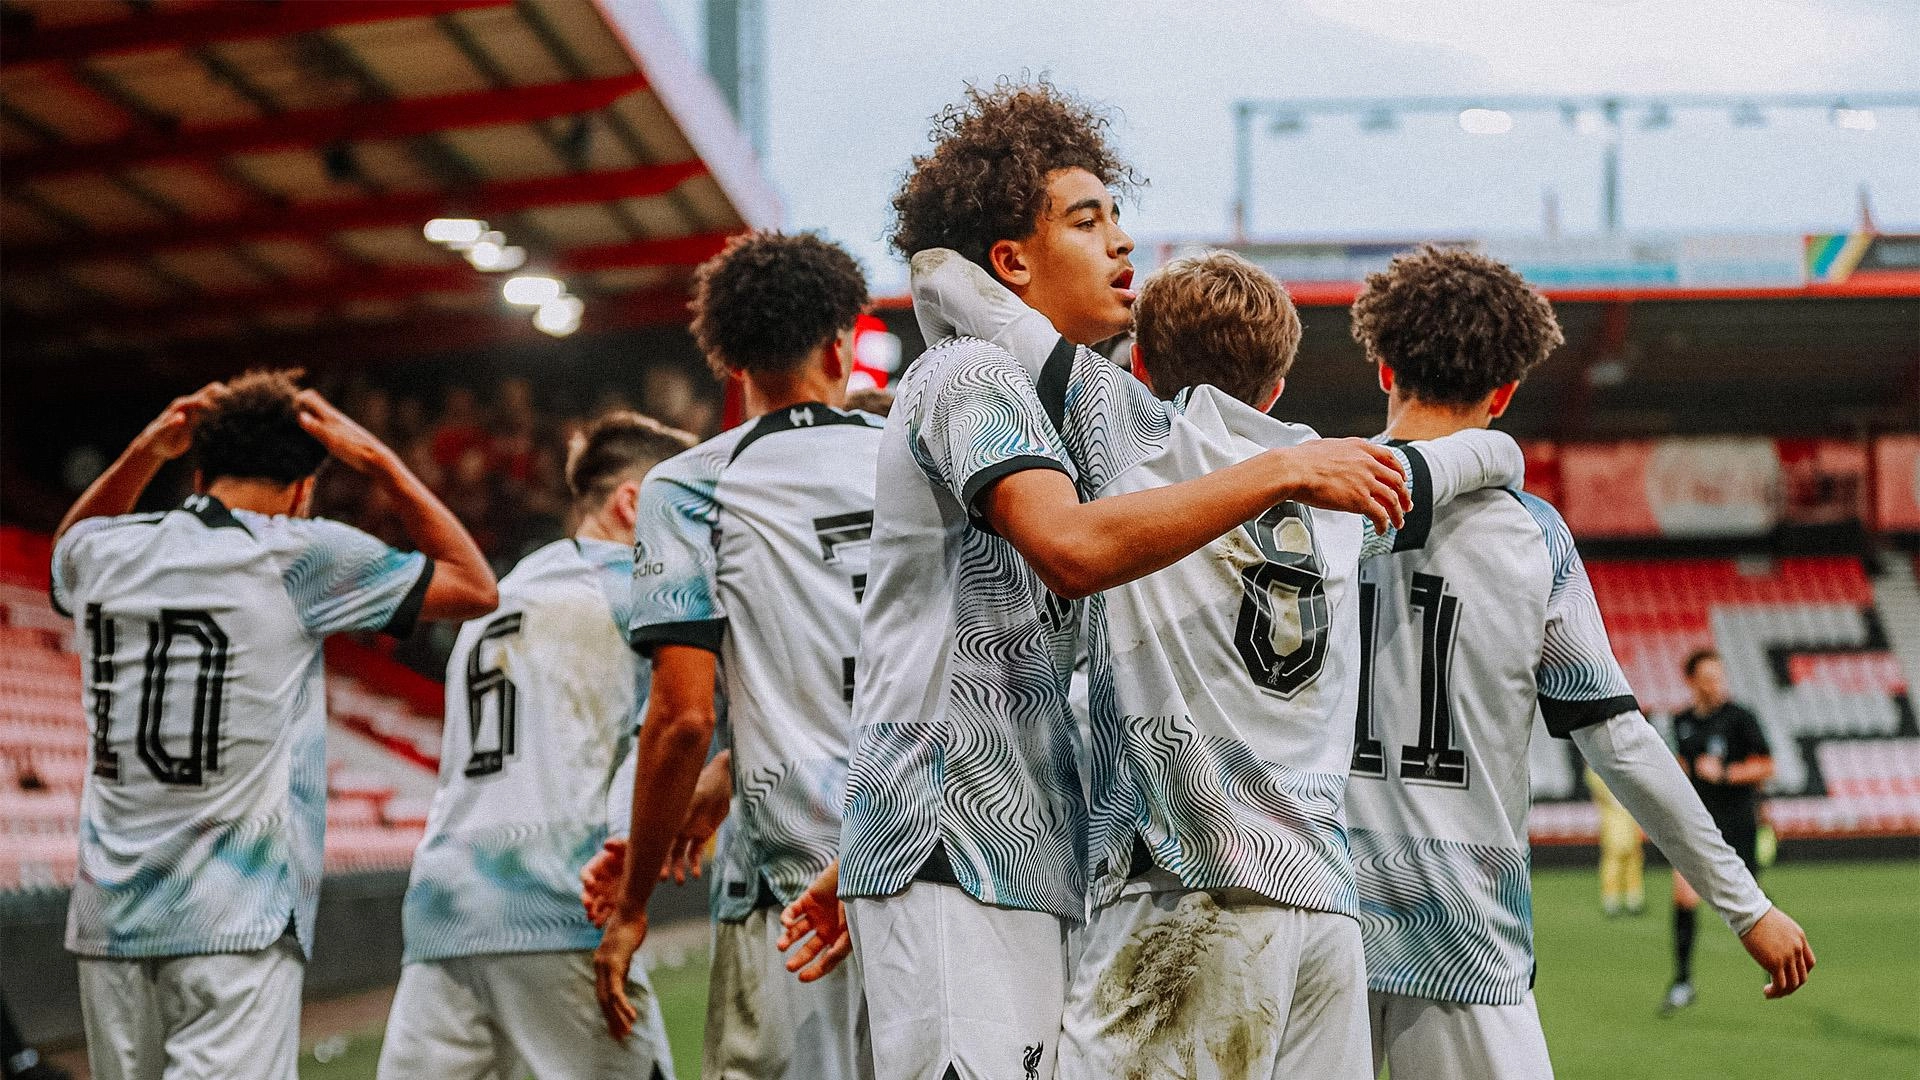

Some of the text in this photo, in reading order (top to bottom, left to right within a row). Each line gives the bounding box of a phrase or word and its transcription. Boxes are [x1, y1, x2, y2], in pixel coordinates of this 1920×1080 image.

[85, 603, 228, 786] 10
[464, 611, 517, 778] 6
[1234, 500, 1333, 702] 8
[1350, 571, 1470, 790] 11
